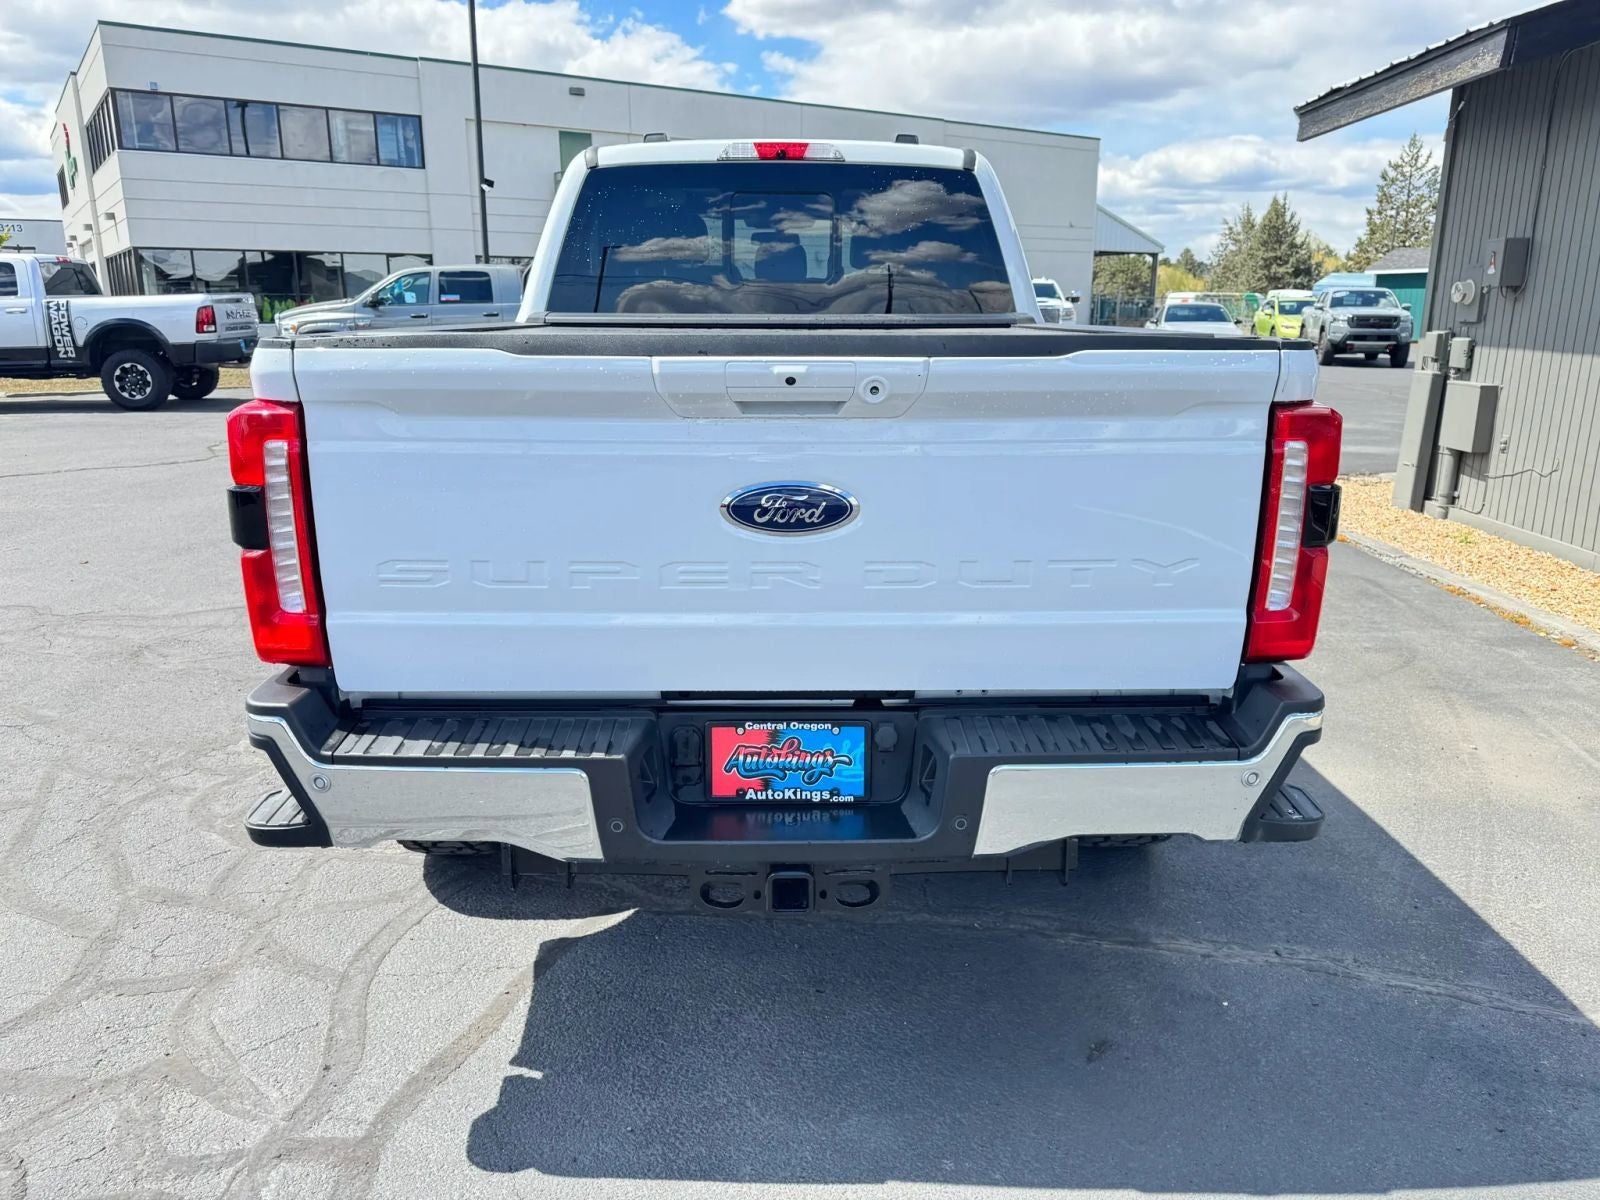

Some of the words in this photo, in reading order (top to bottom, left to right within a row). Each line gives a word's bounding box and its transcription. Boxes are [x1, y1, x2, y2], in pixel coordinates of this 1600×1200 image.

[49, 301, 67, 358] WAGON
[59, 300, 76, 358] POWER
[753, 493, 825, 524] Ford
[375, 559, 822, 589] SUPER
[863, 558, 1200, 589] DUTY
[744, 722, 787, 731] Central
[789, 722, 832, 731] Oregon
